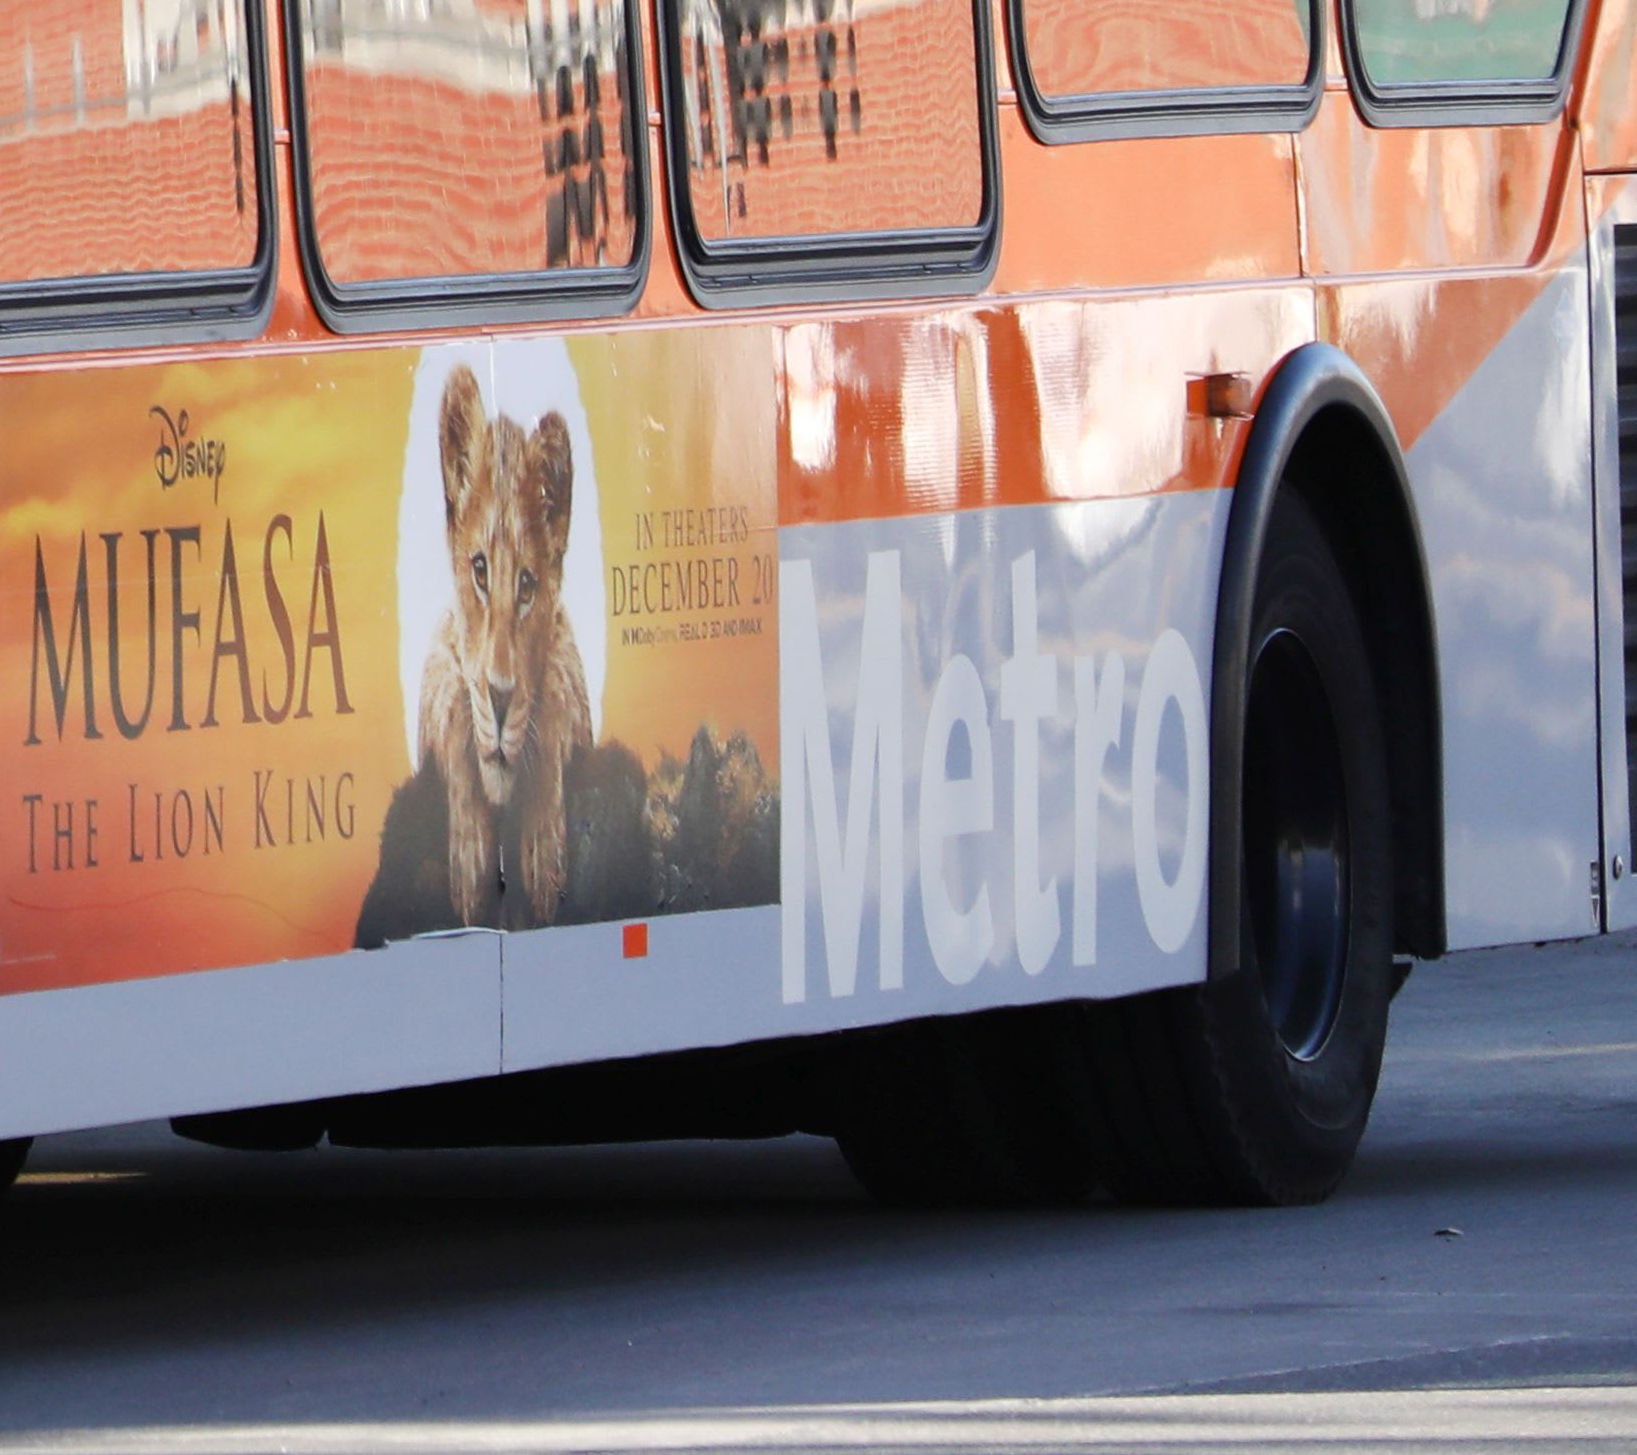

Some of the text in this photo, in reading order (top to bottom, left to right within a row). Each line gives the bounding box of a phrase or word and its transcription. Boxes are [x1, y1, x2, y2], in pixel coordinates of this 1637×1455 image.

[611, 552, 774, 617] DECEMBER 20
[635, 505, 749, 551] IN THEATERS
[22, 508, 356, 747] MUFASA
[778, 549, 1211, 1005] Metro
